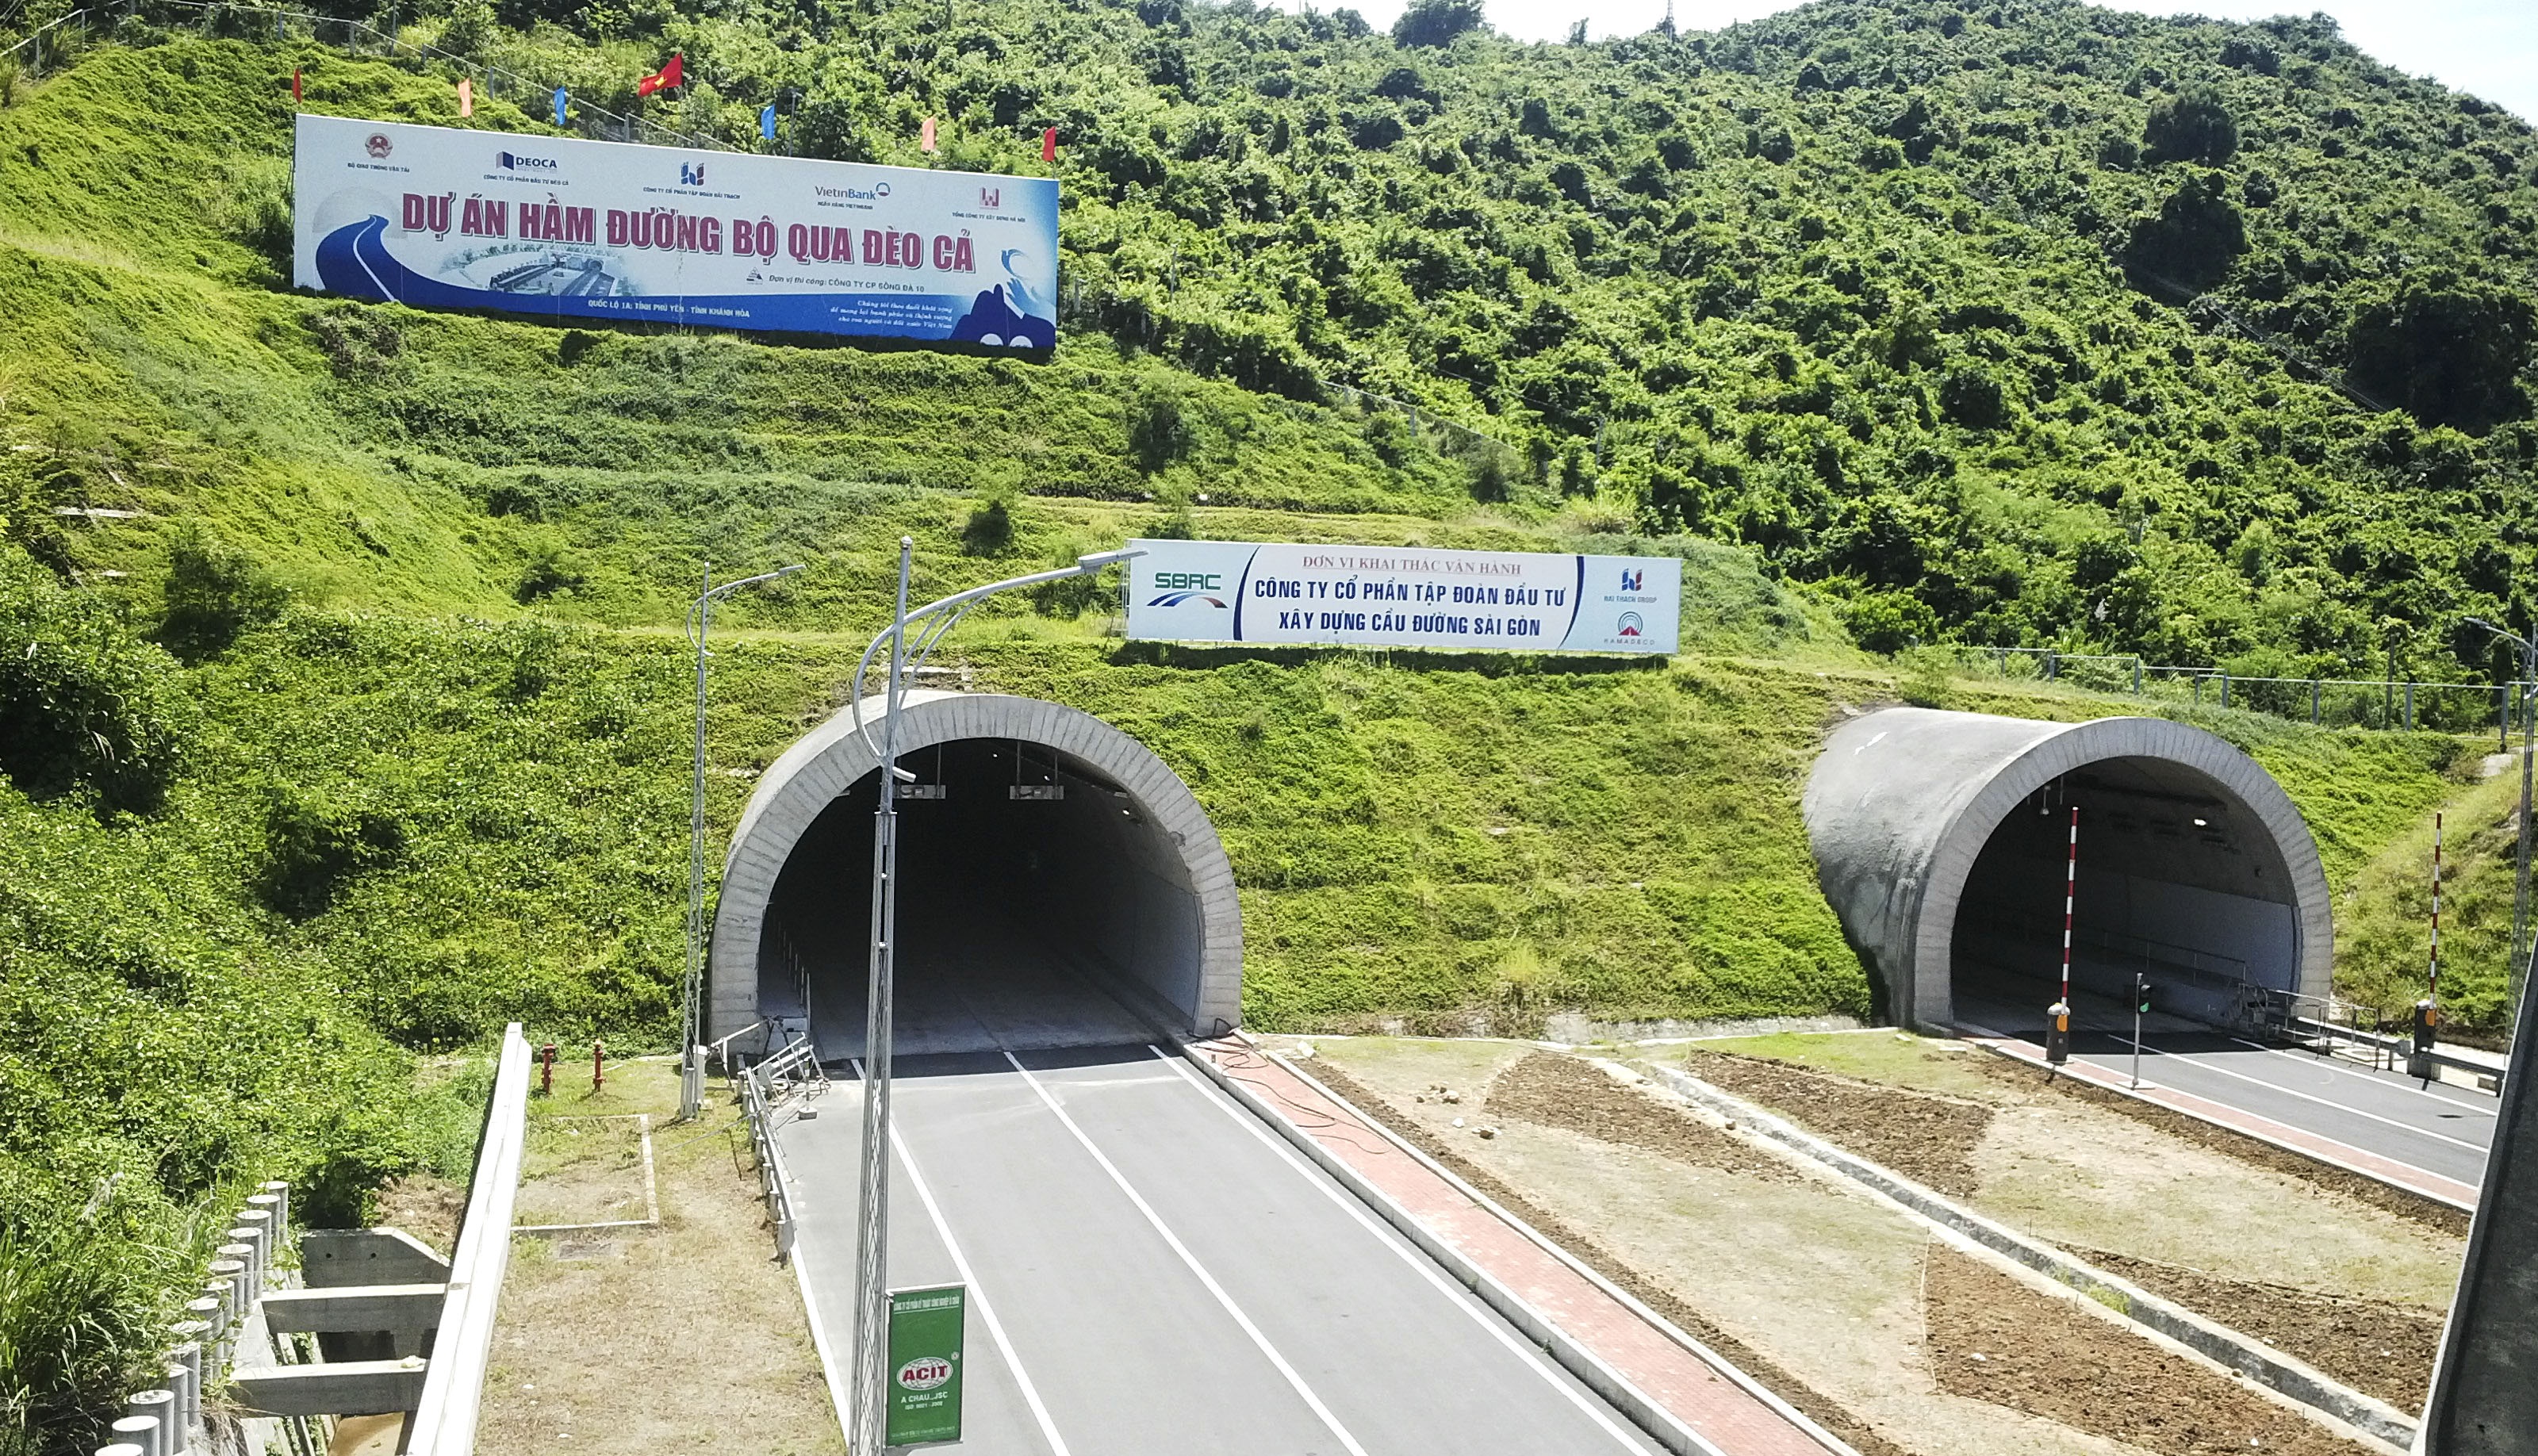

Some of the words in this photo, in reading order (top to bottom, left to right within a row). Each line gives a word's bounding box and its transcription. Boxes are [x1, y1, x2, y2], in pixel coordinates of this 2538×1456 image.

[516, 157, 557, 168] DEOCA
[815, 186, 876, 200] VietinBank
[402, 191, 456, 241] DỰ
[461, 193, 508, 239] ÁN
[519, 192, 596, 246] HẦM
[606, 206, 723, 255] ĐƯỜNG
[732, 215, 778, 266] BỘ
[788, 223, 854, 266] QUA
[862, 225, 924, 270] ĐÈO
[932, 228, 976, 274] CẢ
[1303, 555, 1334, 567] ĐƠN
[1359, 557, 1395, 569] KHAI
[1401, 557, 1440, 571] THÁC
[1480, 561, 1520, 574] HÀNH
[1155, 573, 1221, 590] SBRC
[1256, 577, 1301, 598] CÔNG
[1307, 581, 1328, 599] TY
[1335, 574, 1358, 600] CỔ
[1415, 581, 1446, 606] TẬP
[1453, 583, 1498, 604] ĐOÀN
[1545, 587, 1566, 607] TƯ
[1279, 608, 1314, 629] XÂY
[1321, 610, 1366, 634] DỰNG
[1413, 611, 1468, 634] ĐƯỜNG
[1474, 614, 1501, 635] SÀI
[1508, 615, 1540, 636] GÒN
[903, 1365, 948, 1381] ACIT
